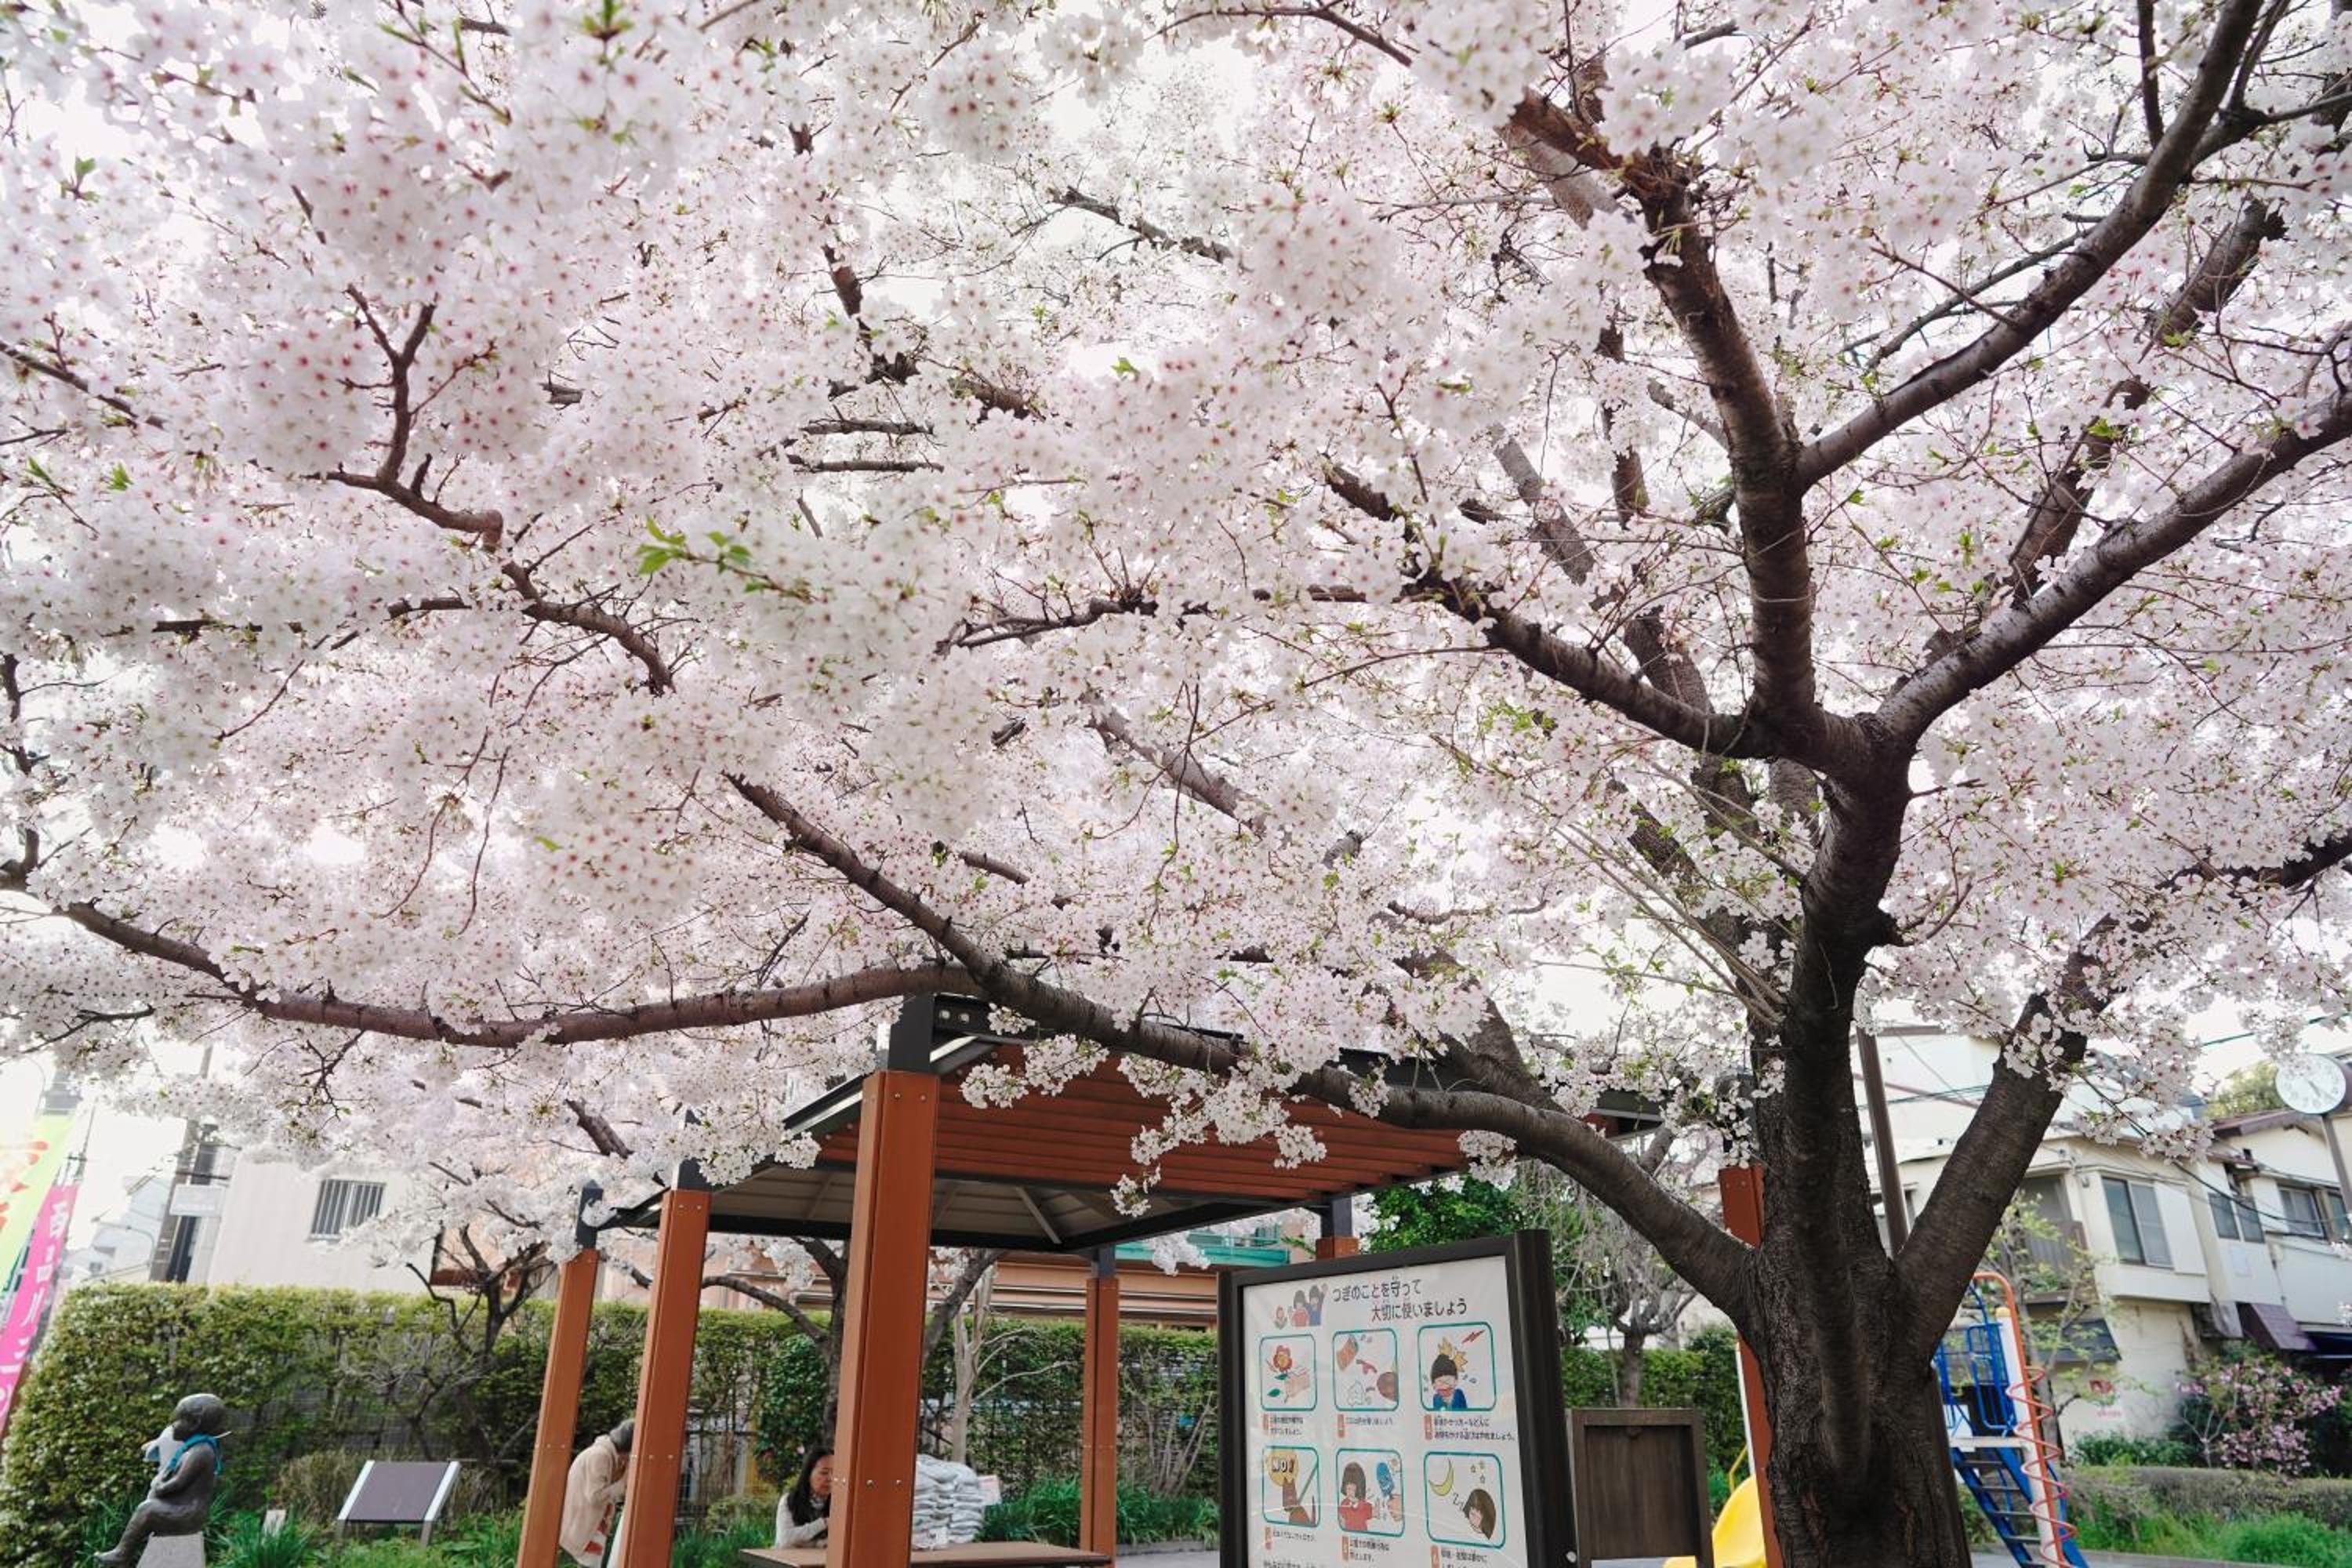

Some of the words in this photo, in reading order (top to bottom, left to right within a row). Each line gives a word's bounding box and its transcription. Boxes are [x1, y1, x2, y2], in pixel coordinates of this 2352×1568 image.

[1333, 1279, 1421, 1301] つぎのことを守って
[1372, 1298, 1467, 1321] 大切に使いましょう
